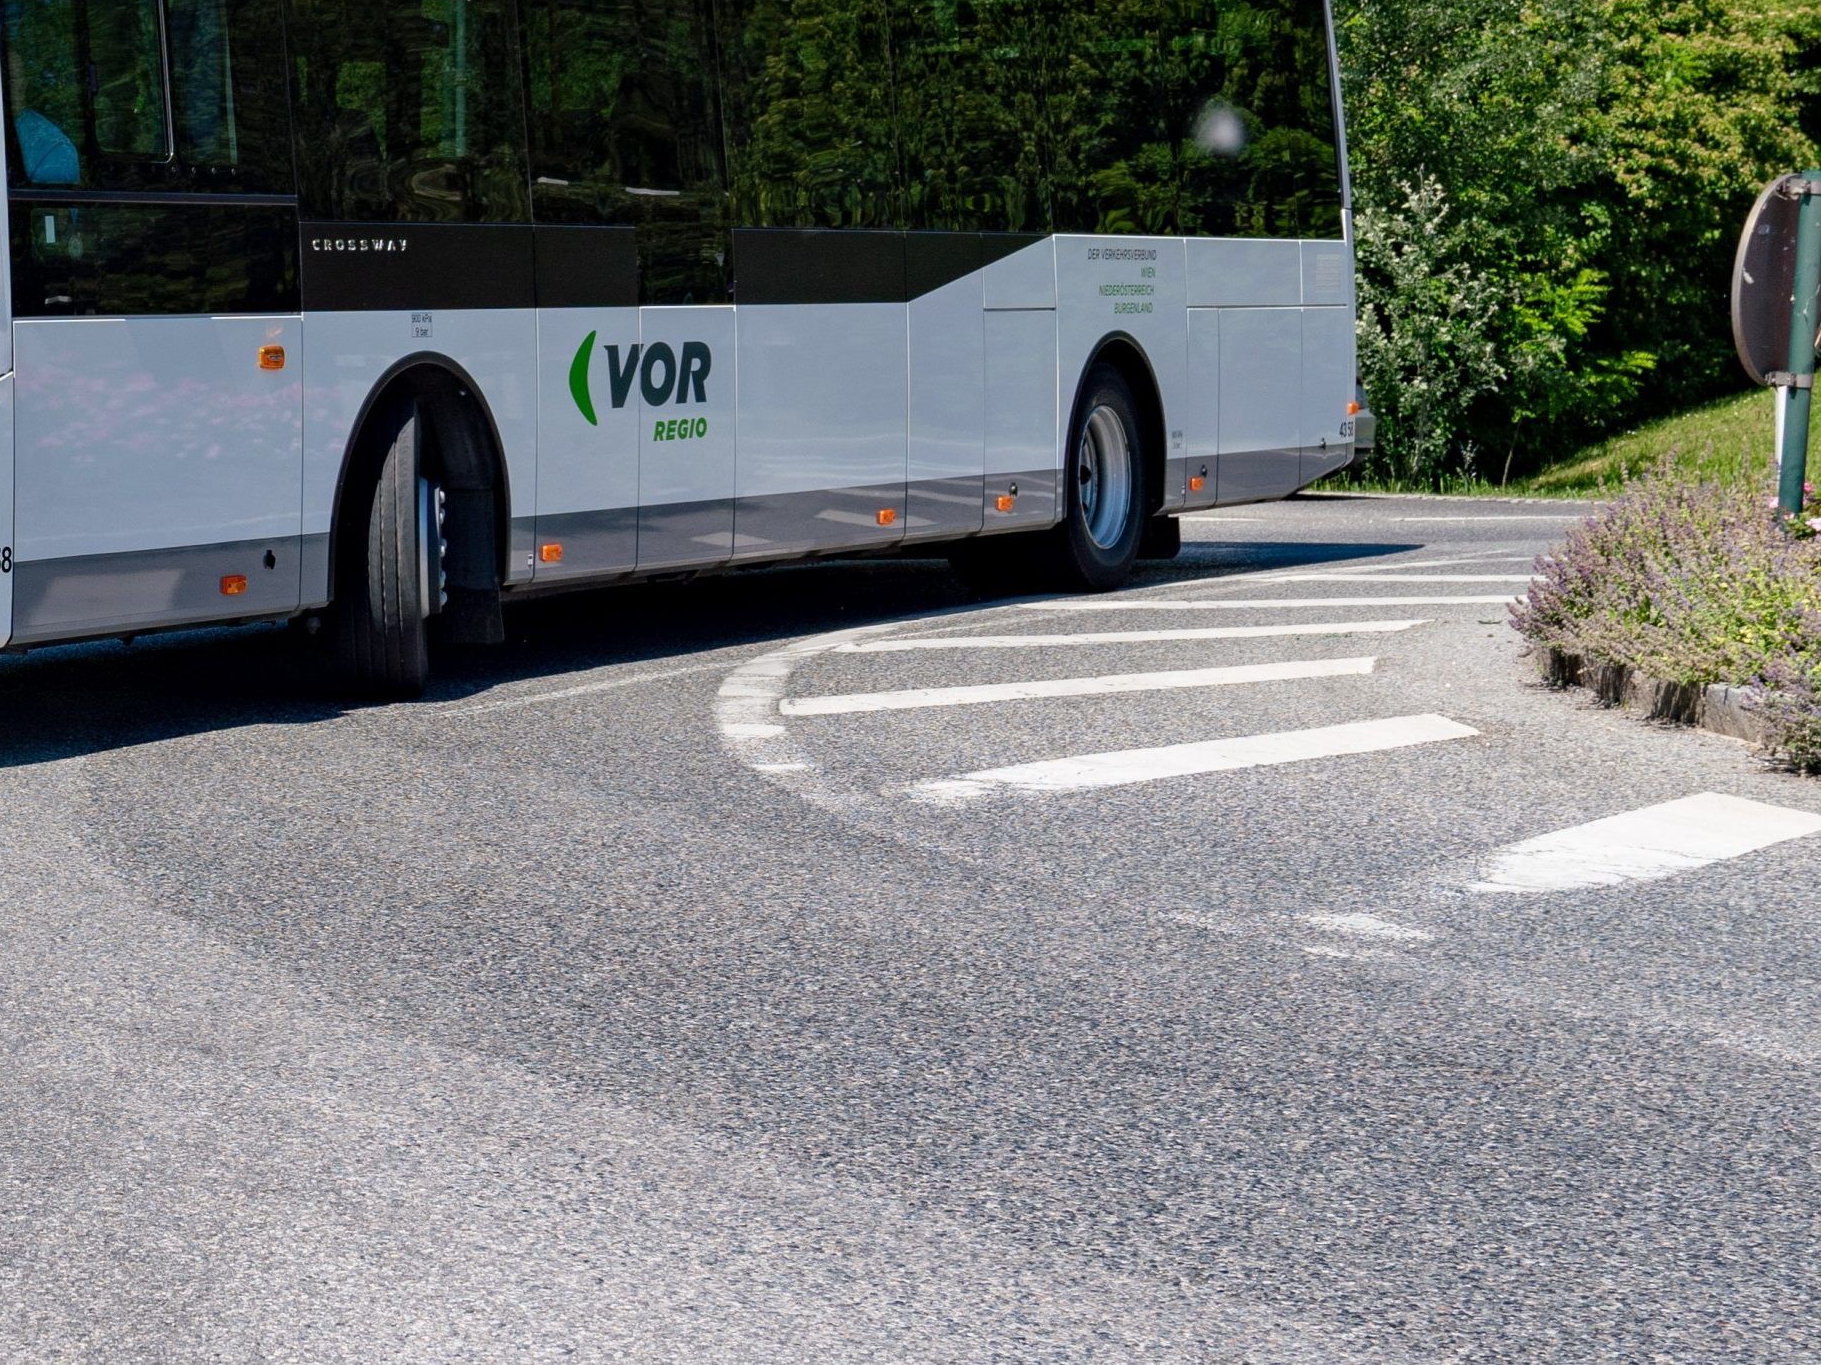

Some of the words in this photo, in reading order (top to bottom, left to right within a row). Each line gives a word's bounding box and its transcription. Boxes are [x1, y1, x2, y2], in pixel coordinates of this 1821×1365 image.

[311, 238, 407, 252] CROSSWAY
[603, 341, 712, 409] VOR
[653, 417, 708, 442] REGIO
